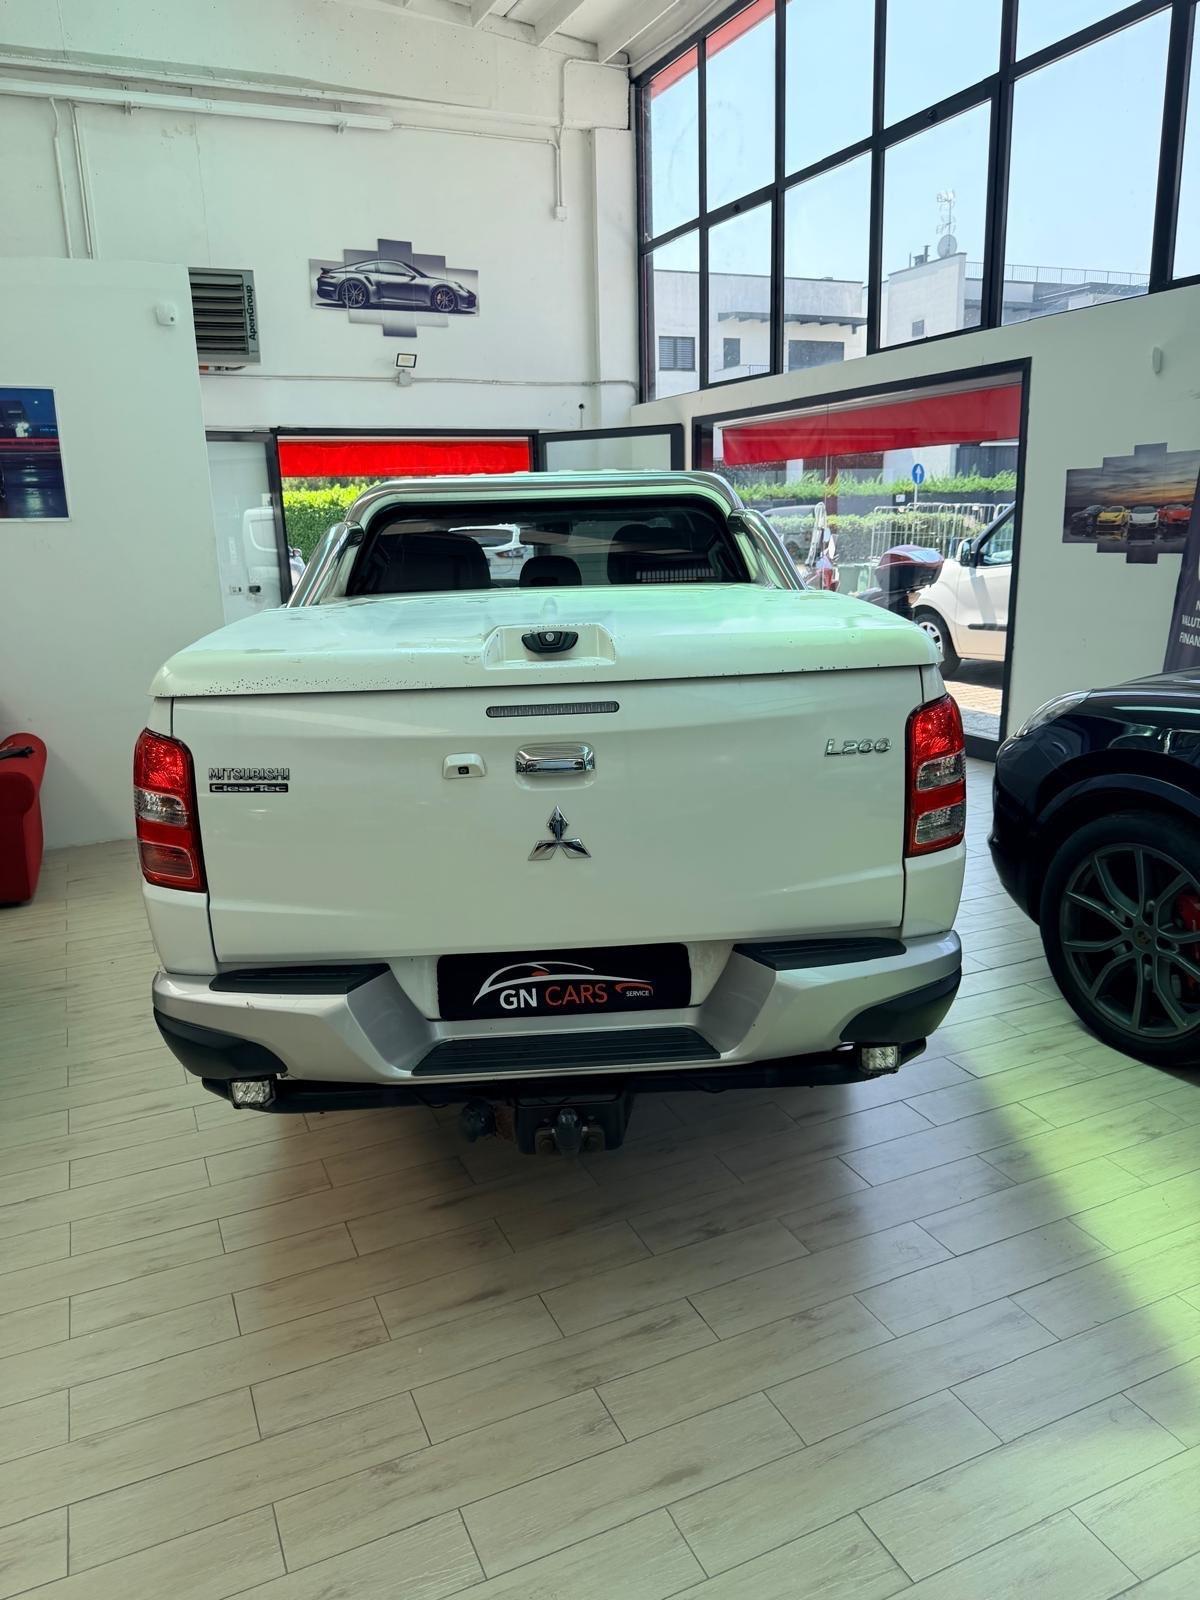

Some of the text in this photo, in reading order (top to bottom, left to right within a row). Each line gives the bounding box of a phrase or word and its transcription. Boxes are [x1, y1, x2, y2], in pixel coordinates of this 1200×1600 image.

[245, 285, 257, 341] ApenGroup
[824, 737, 891, 757] L200
[208, 767, 290, 781] MITSUBISHI
[210, 783, 288, 792] ClearTec
[499, 983, 608, 1010] GN CARS
[625, 989, 650, 997] SERVICE
